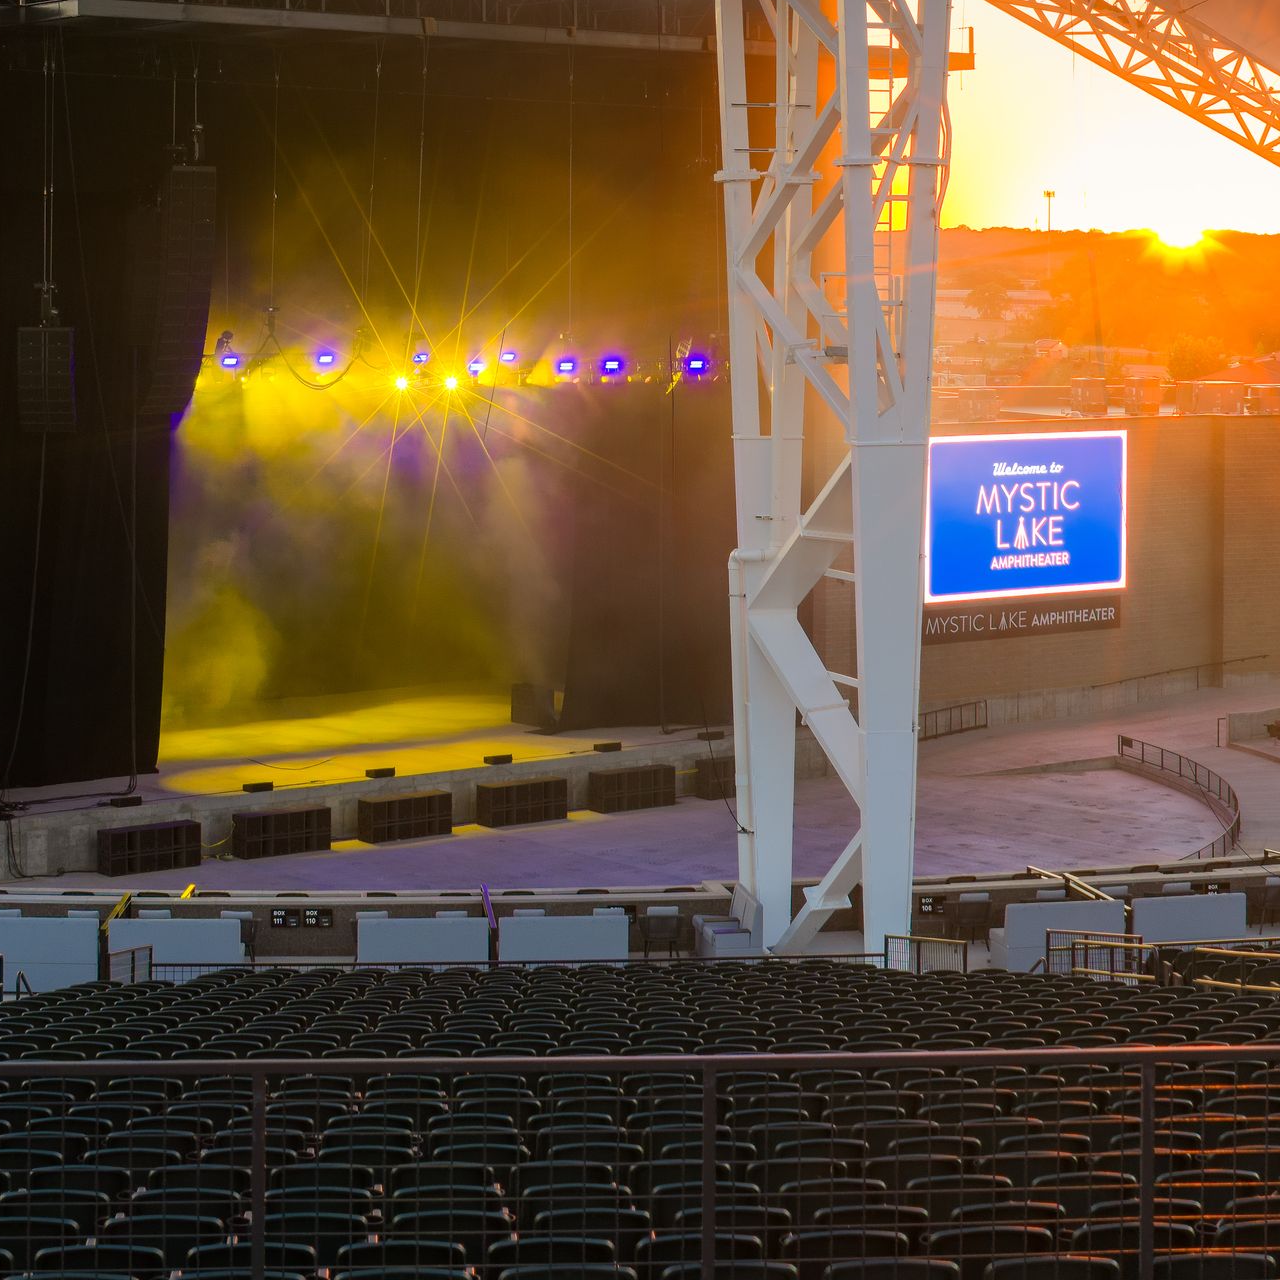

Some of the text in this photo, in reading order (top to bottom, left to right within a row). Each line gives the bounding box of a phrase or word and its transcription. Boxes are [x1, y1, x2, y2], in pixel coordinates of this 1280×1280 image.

[992, 461, 1064, 477] Welcome to
[975, 481, 1080, 515] MYSTIC
[996, 516, 1064, 549] LAKE
[990, 551, 1070, 570] AMPHITHEATER
[926, 606, 1116, 636] MYSTIC LAKE AMPHITHEATER
